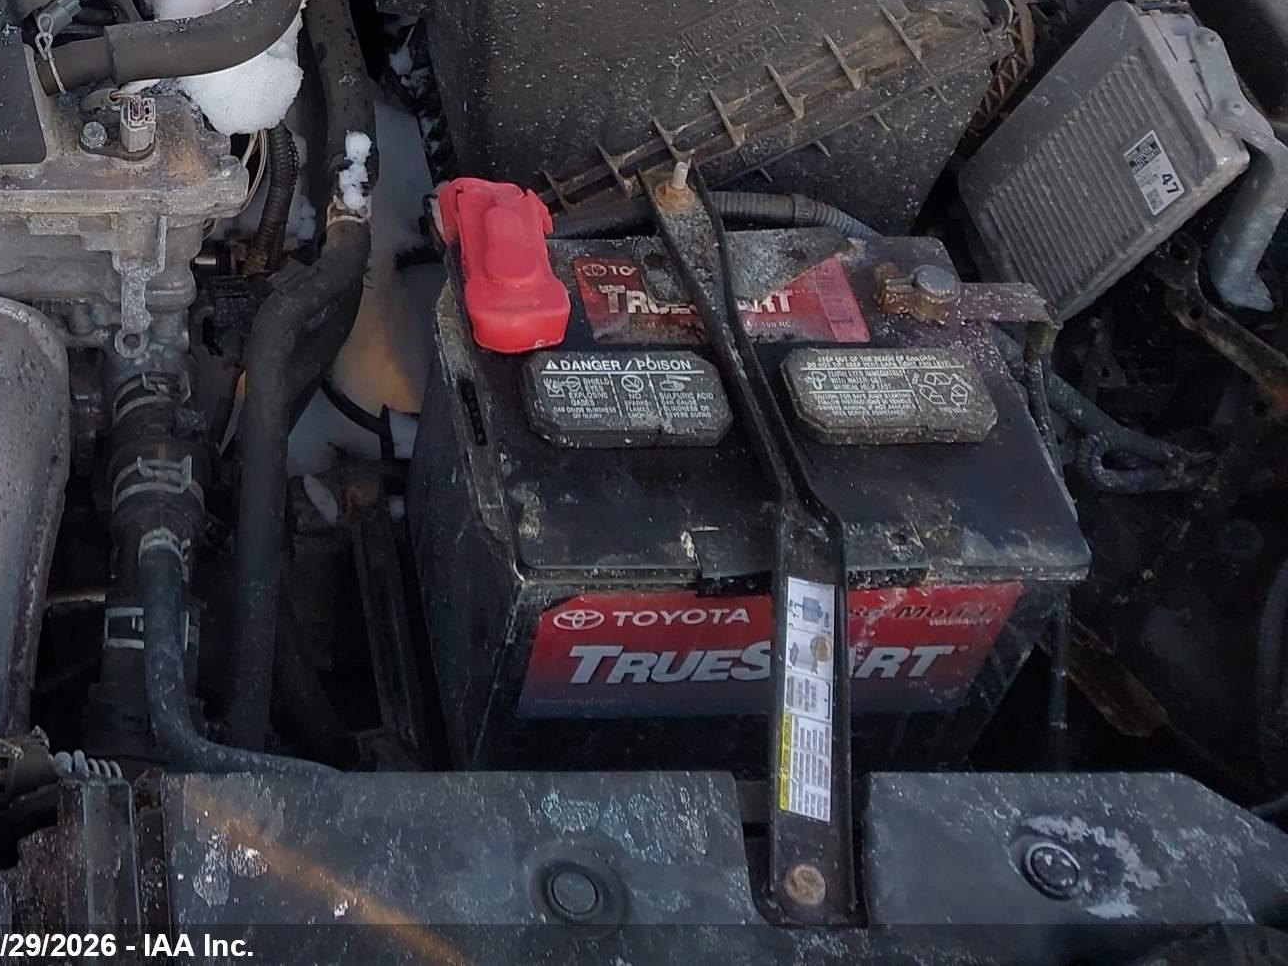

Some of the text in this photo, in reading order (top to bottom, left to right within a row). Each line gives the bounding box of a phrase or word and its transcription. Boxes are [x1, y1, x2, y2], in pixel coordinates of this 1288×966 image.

[1161, 173, 1180, 194] 47
[560, 359, 622, 371] DANGER
[636, 359, 692, 371] POISON
[628, 392, 642, 400] NO
[697, 392, 714, 400] ACID
[612, 608, 751, 627] TOYOTA
